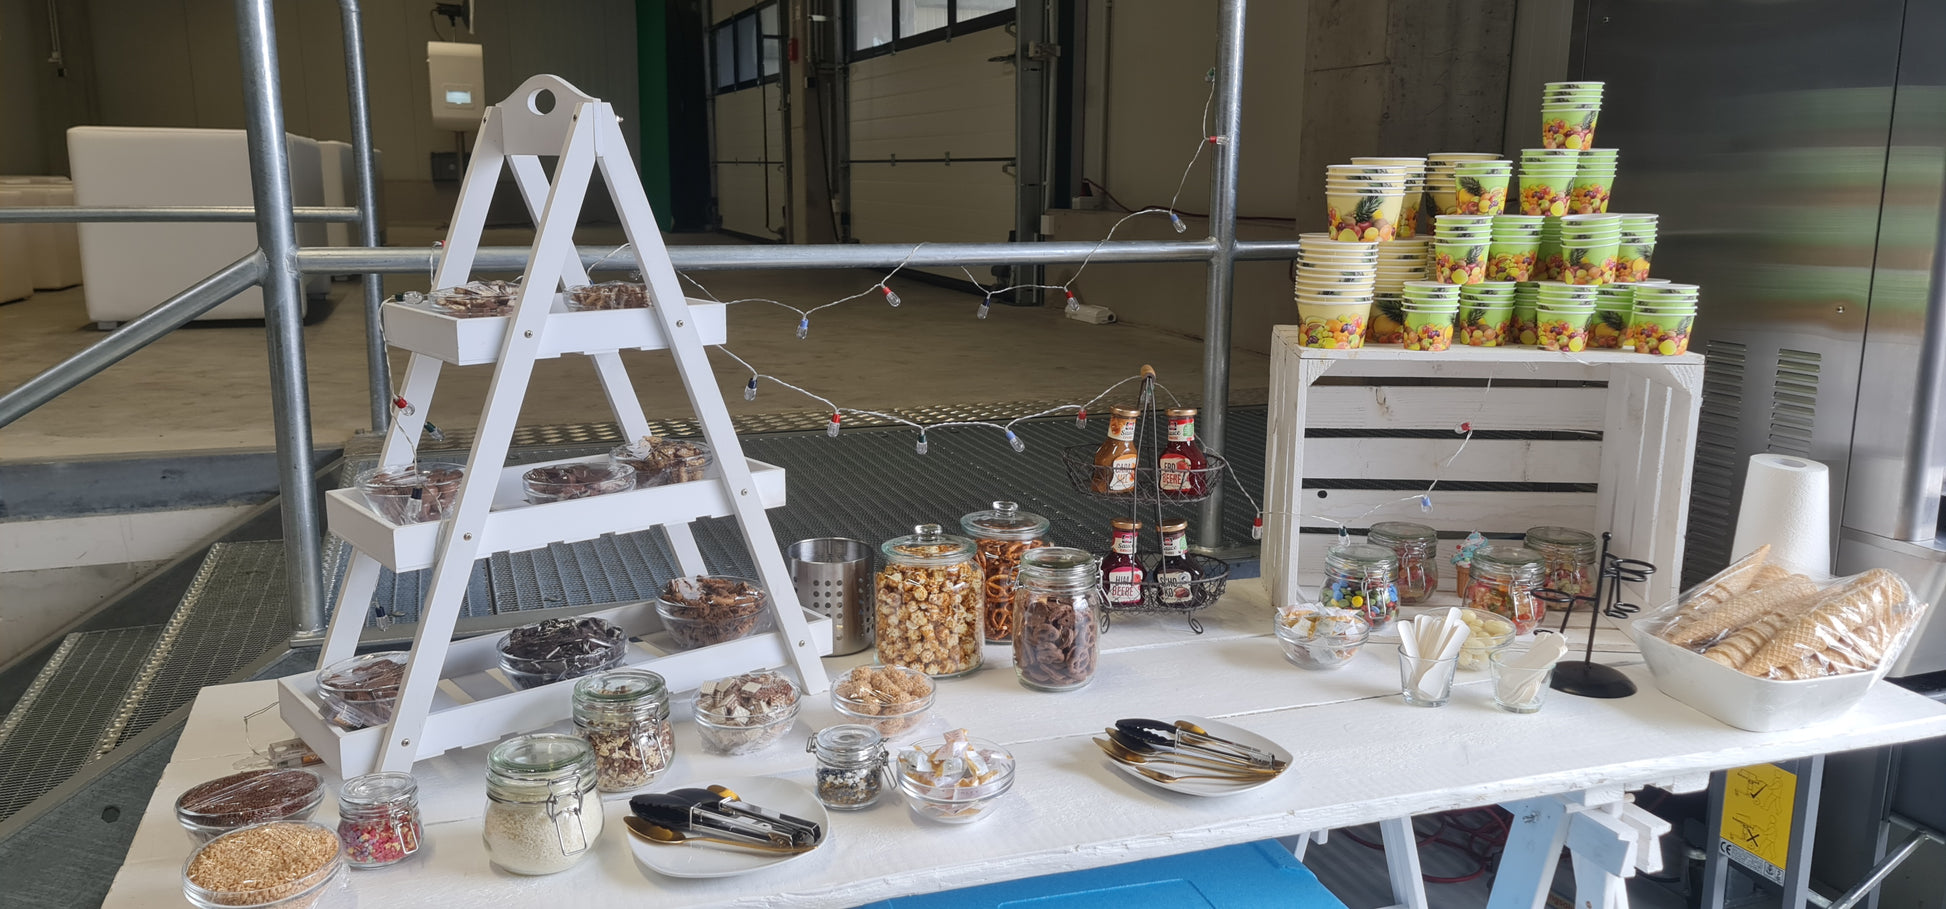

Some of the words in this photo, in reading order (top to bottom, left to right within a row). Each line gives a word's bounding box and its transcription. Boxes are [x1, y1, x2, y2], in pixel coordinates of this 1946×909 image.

[1162, 473, 1181, 485] BEERE
[1115, 575, 1130, 586] HIM
[1160, 576, 1177, 588] SCHO
[1112, 586, 1133, 597] BEERE
[1164, 588, 1174, 598] KO
